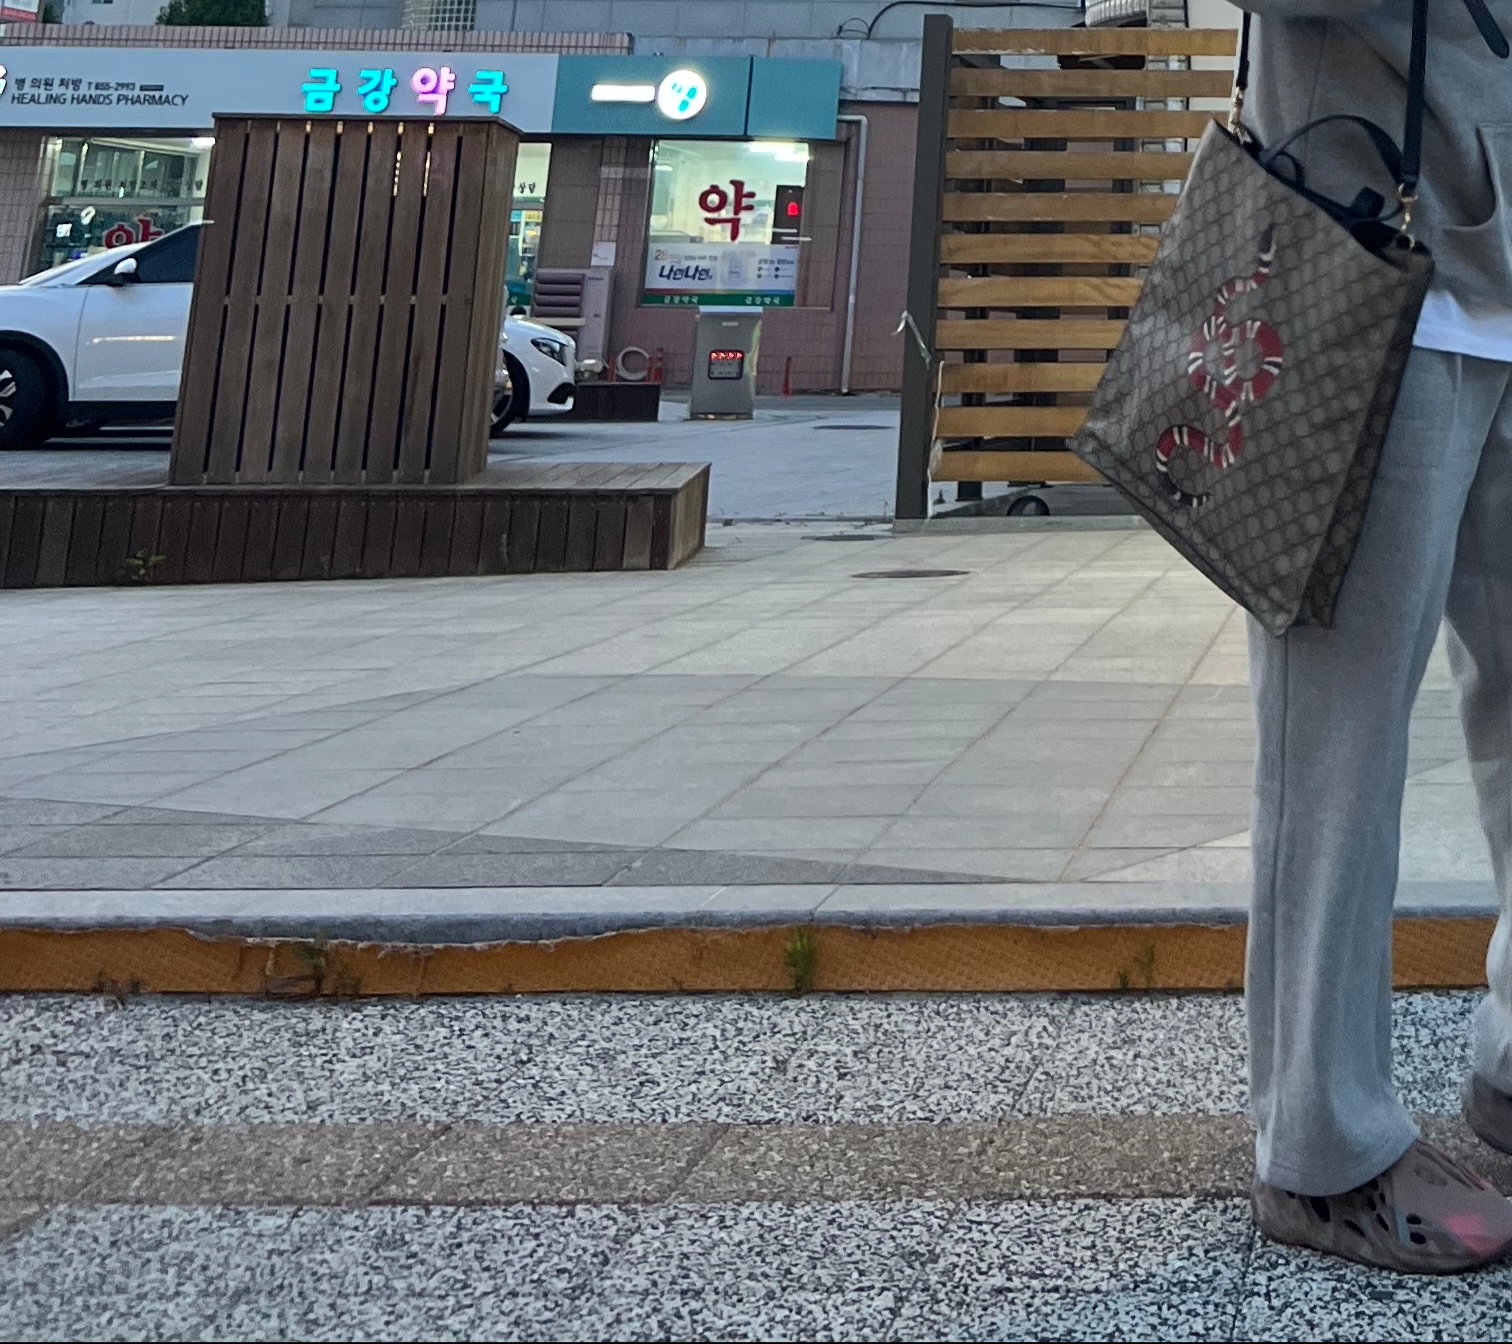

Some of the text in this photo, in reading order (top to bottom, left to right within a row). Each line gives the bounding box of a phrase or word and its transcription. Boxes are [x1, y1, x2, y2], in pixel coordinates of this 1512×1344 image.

[11, 93, 189, 106] HEALING HANDS PHARMACY
[301, 66, 508, 116] 금강약국
[699, 180, 756, 241] 약
